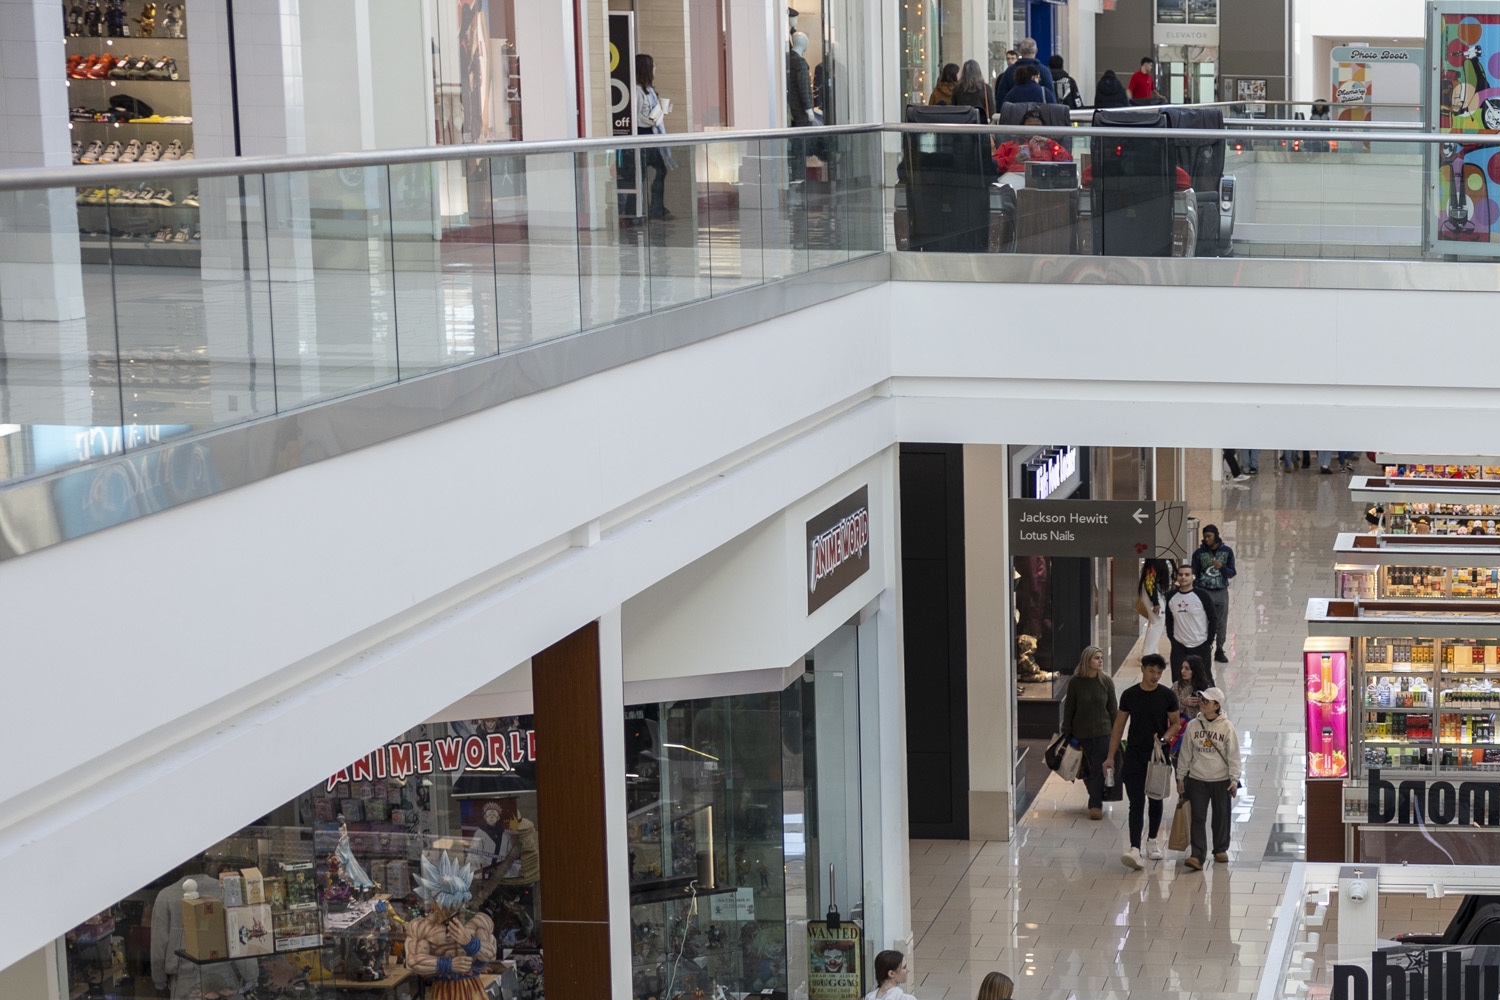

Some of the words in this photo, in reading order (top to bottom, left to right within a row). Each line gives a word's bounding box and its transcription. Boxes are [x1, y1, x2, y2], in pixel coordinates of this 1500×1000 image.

[1166, 31, 1208, 39] ELEVATOR
[1350, 50, 1378, 59] Photo
[1381, 51, 1408, 60] Booth
[615, 117, 630, 128] off
[1020, 512, 1066, 523] Jackson
[1069, 513, 1108, 524] Hewitt
[1020, 530, 1048, 541] Lotus
[1050, 530, 1075, 541] Nails
[1194, 730, 1225, 742] ROWAN
[807, 927, 858, 940] WANTED
